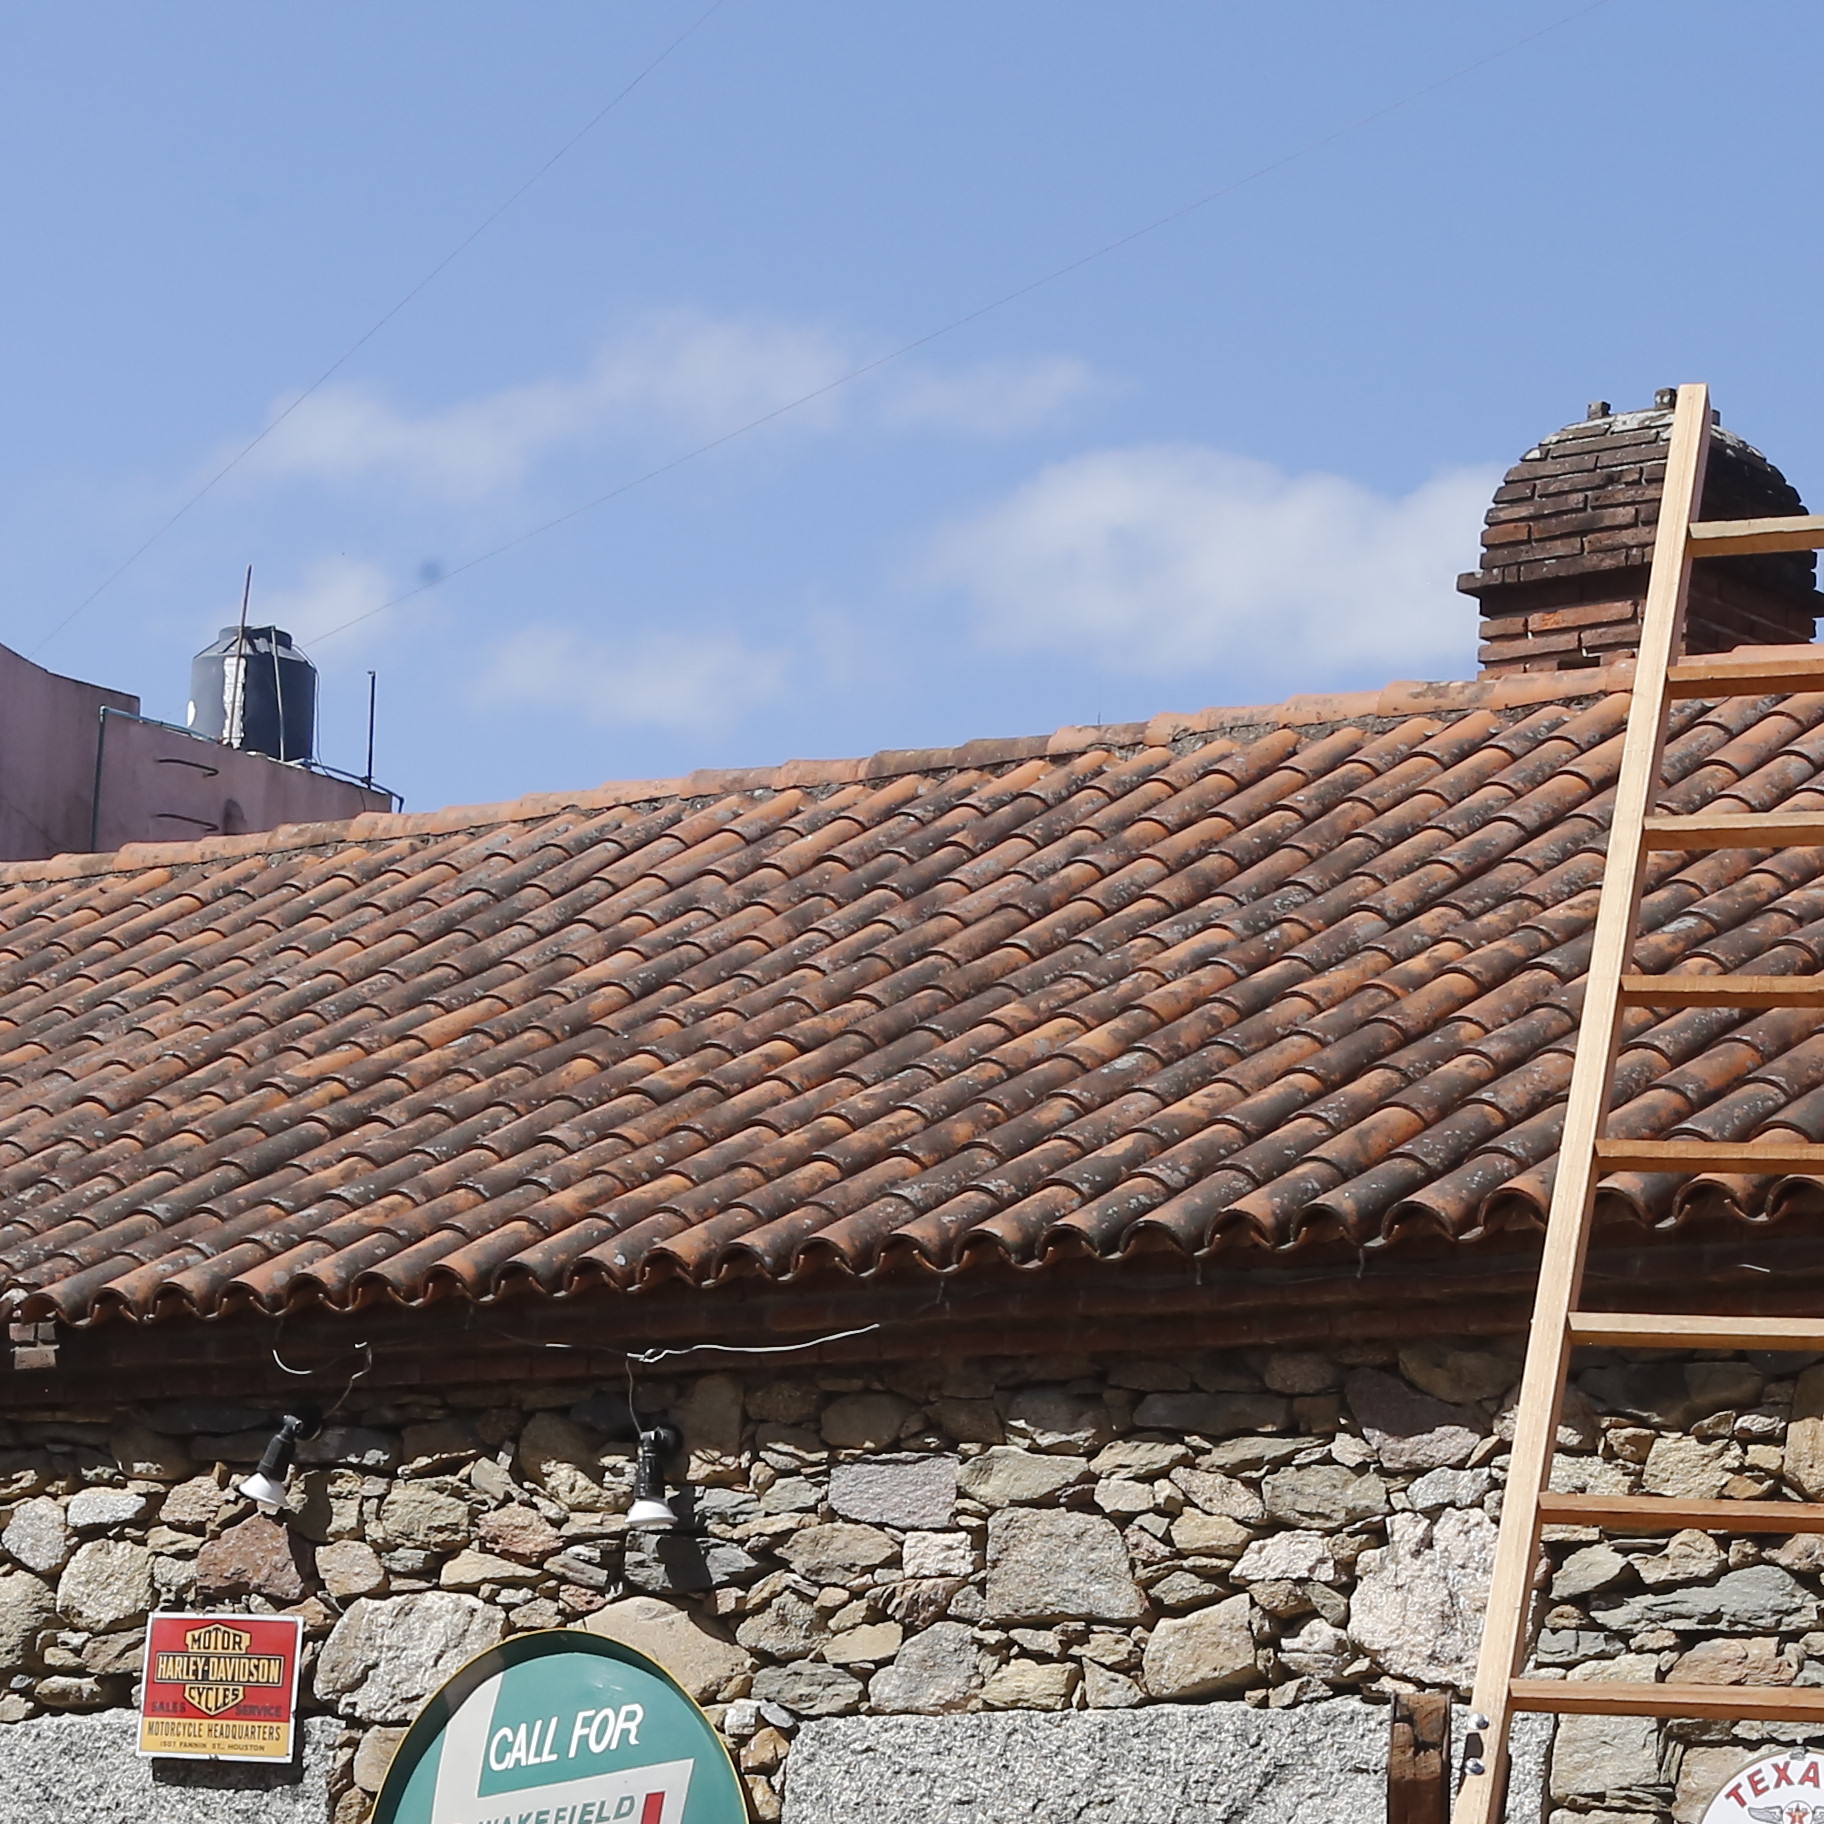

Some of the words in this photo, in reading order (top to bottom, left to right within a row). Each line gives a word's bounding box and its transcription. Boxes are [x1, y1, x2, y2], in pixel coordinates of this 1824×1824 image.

[191, 1627, 243, 1650] MOTOR
[157, 1655, 280, 1684] HARLEY-DAVIDSON
[151, 1701, 186, 1713] SALES
[235, 1704, 282, 1717] SERVICE
[188, 1687, 240, 1712] CYCLES
[148, 1721, 203, 1738] MOTORCYCLE
[207, 1723, 281, 1741] HEADQUARTERS
[488, 1715, 559, 1772] CALL
[567, 1703, 645, 1759] FOR
[228, 1744, 265, 1752] HOUSTON
